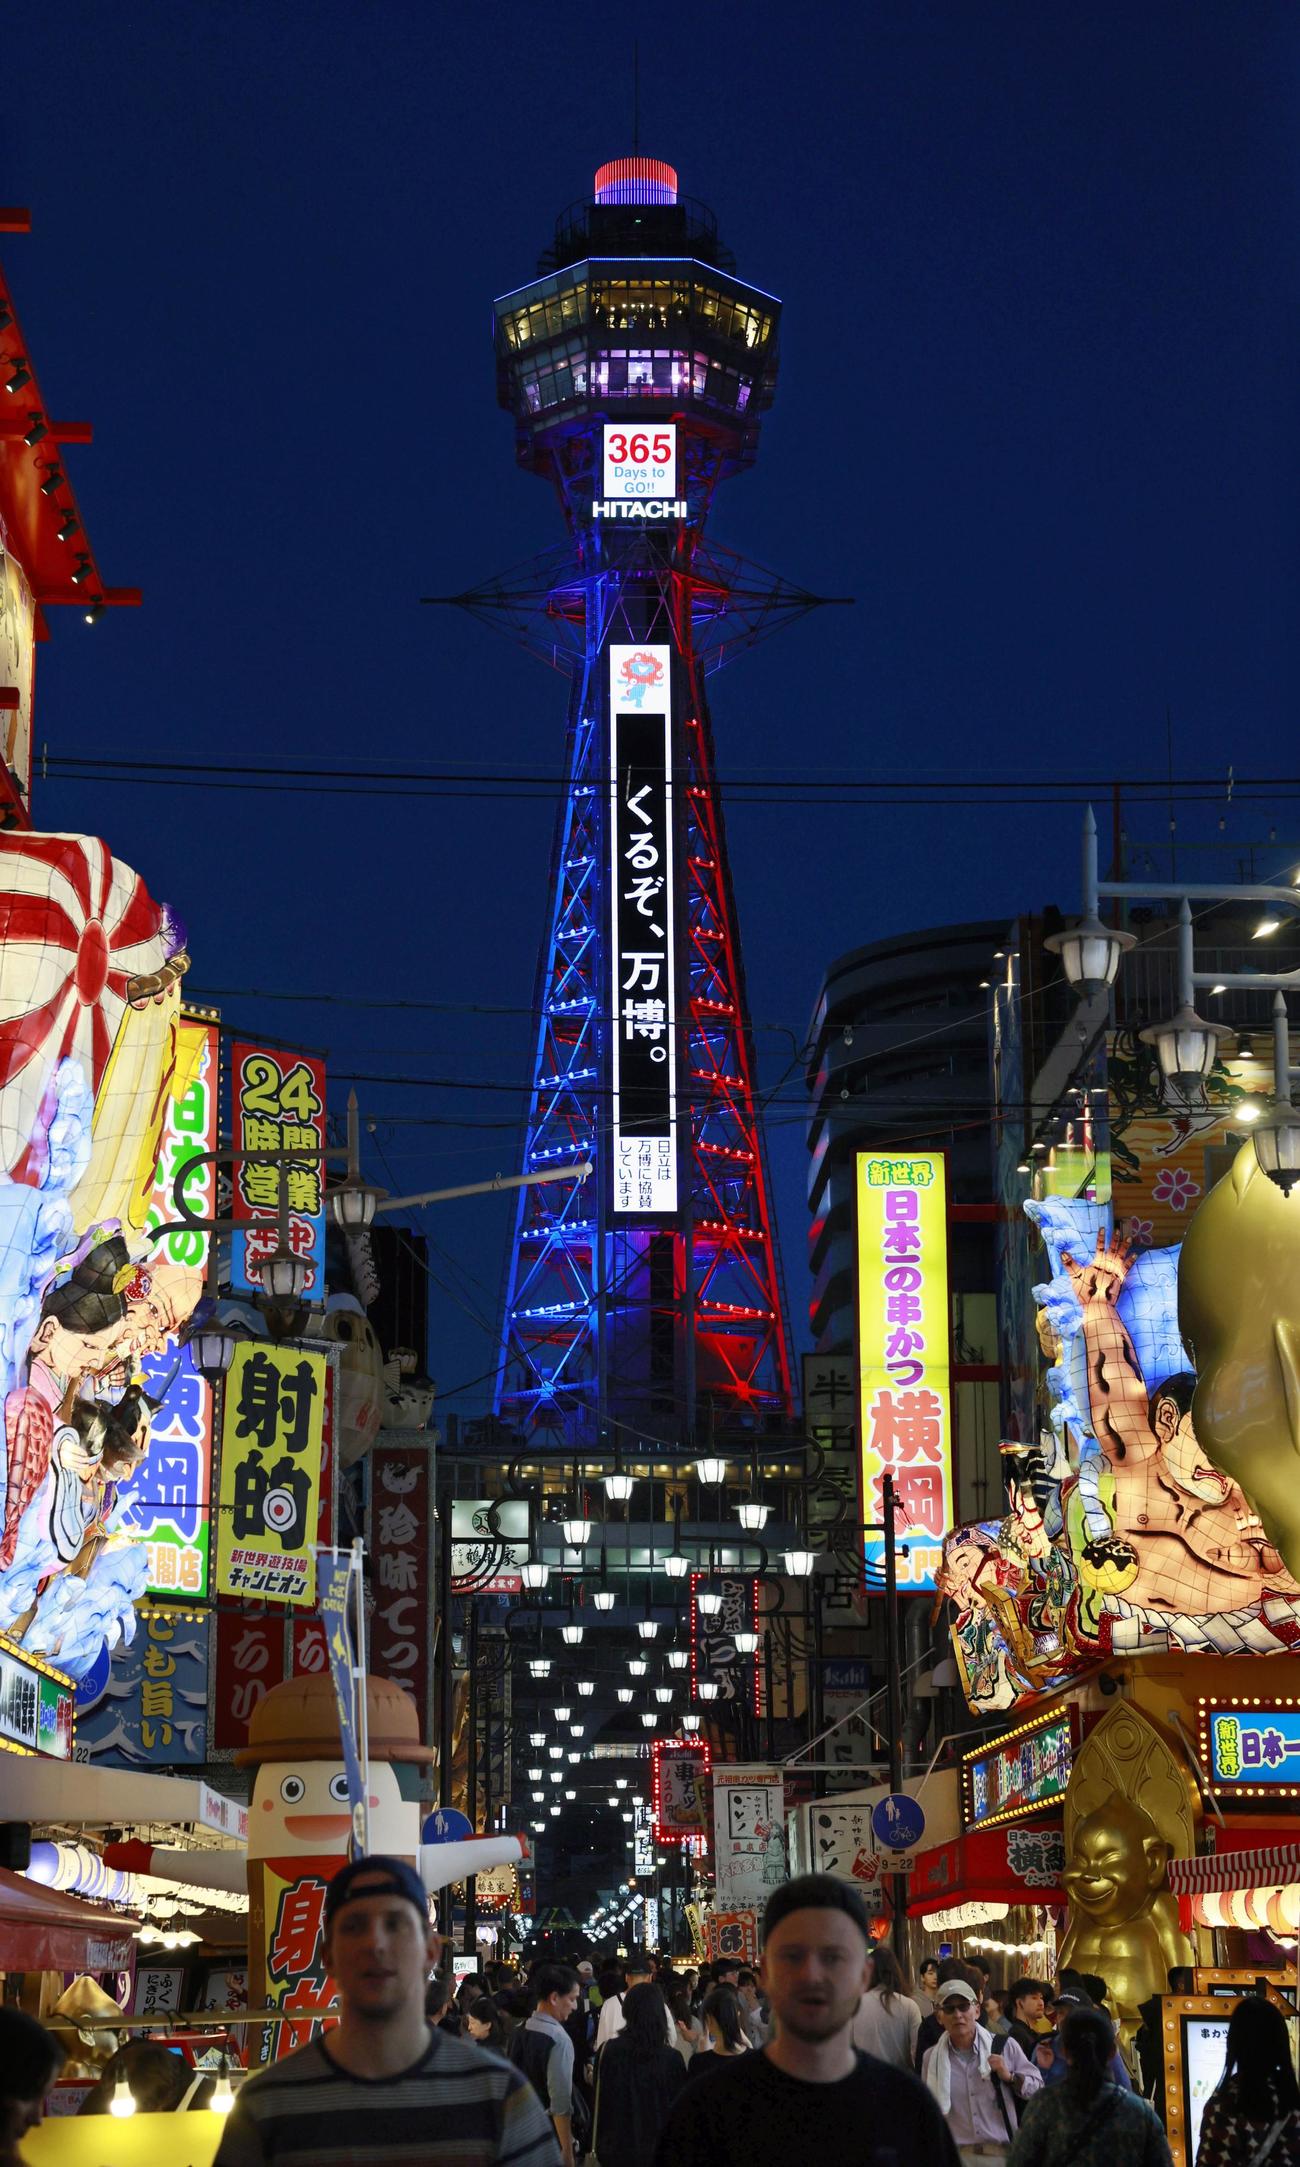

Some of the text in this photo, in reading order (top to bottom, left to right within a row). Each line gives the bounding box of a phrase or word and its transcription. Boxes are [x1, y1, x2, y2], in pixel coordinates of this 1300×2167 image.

[608, 434, 671, 463] 365
[614, 466, 665, 478] Days to
[624, 483, 655, 493] GO!!
[592, 501, 687, 518] HITACHI
[621, 785, 667, 1063] くるぞ、万博。
[243, 1055, 321, 1121] 24
[619, 1140, 632, 1207] しています
[638, 1140, 652, 1208] 万博に協賛
[658, 1140, 671, 1180] 日立は
[868, 1160, 933, 1186] 新世界
[883, 1190, 924, 1386] 日本一の串かつ
[232, 1352, 317, 1550] 射的
[870, 1390, 943, 1537] 横綱
[229, 1568, 307, 1596] チャンピオン
[1218, 1719, 1239, 1776] 新世界
[1242, 1730, 1300, 1766] 日本一
[881, 1859, 913, 1870] 9-22
